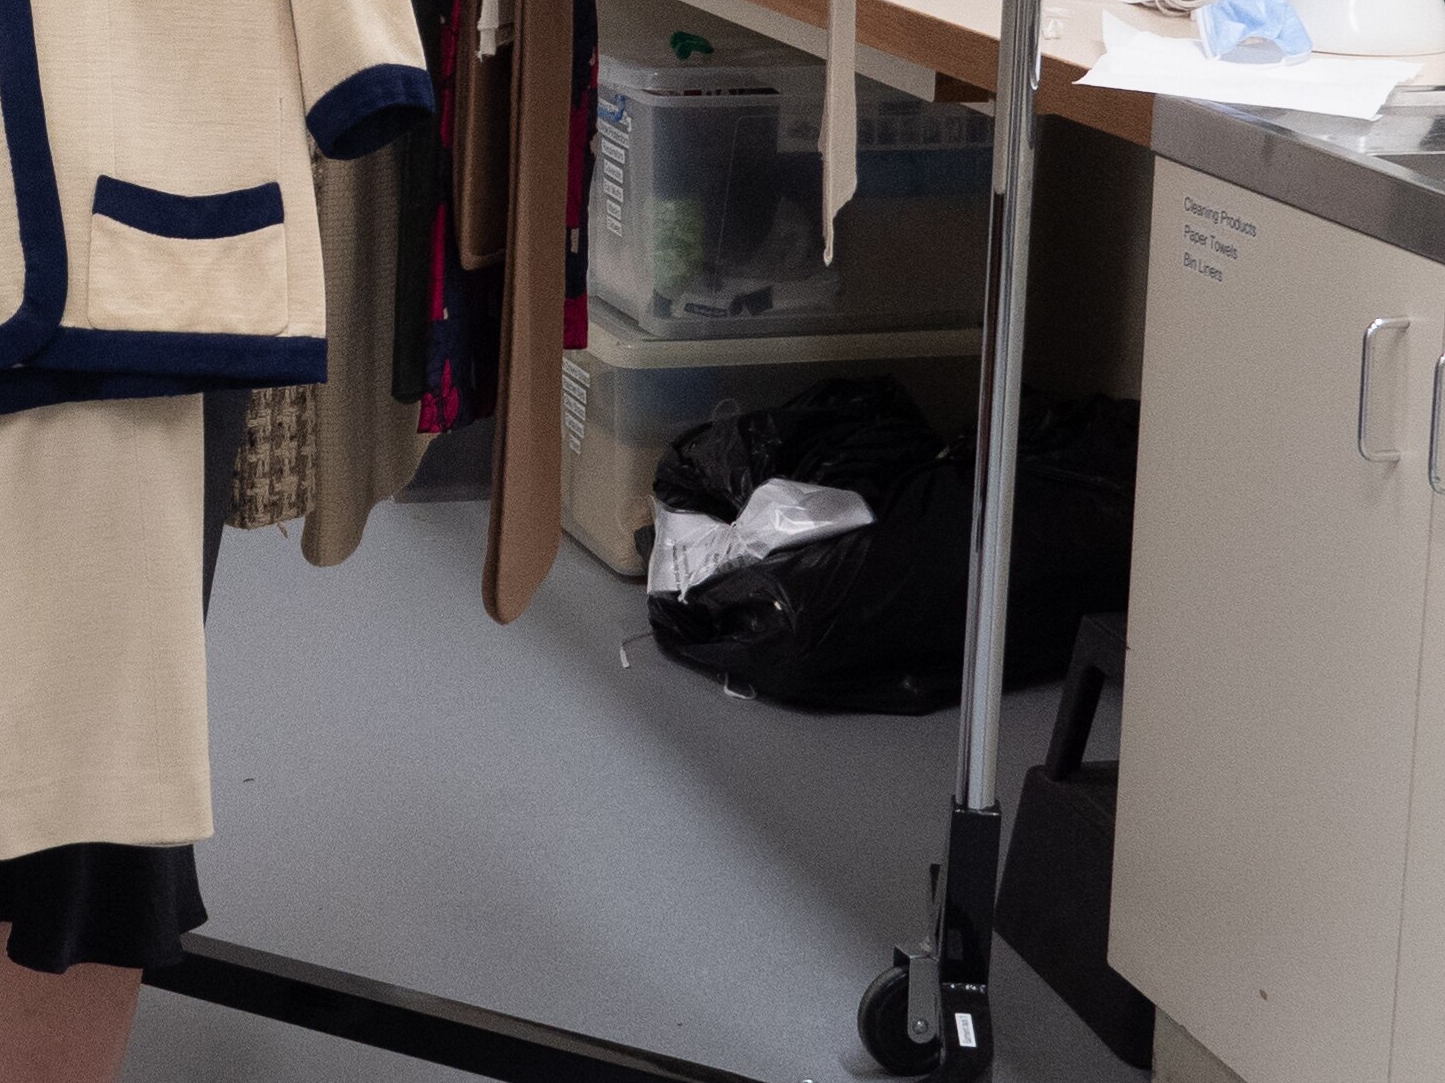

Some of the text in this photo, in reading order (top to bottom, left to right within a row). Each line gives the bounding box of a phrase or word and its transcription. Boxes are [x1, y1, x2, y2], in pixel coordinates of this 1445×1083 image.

[1183, 196, 1257, 237] Cleaning Products
[1183, 224, 1238, 260] Paper Towels
[1183, 252, 1223, 282] Bin Liners
